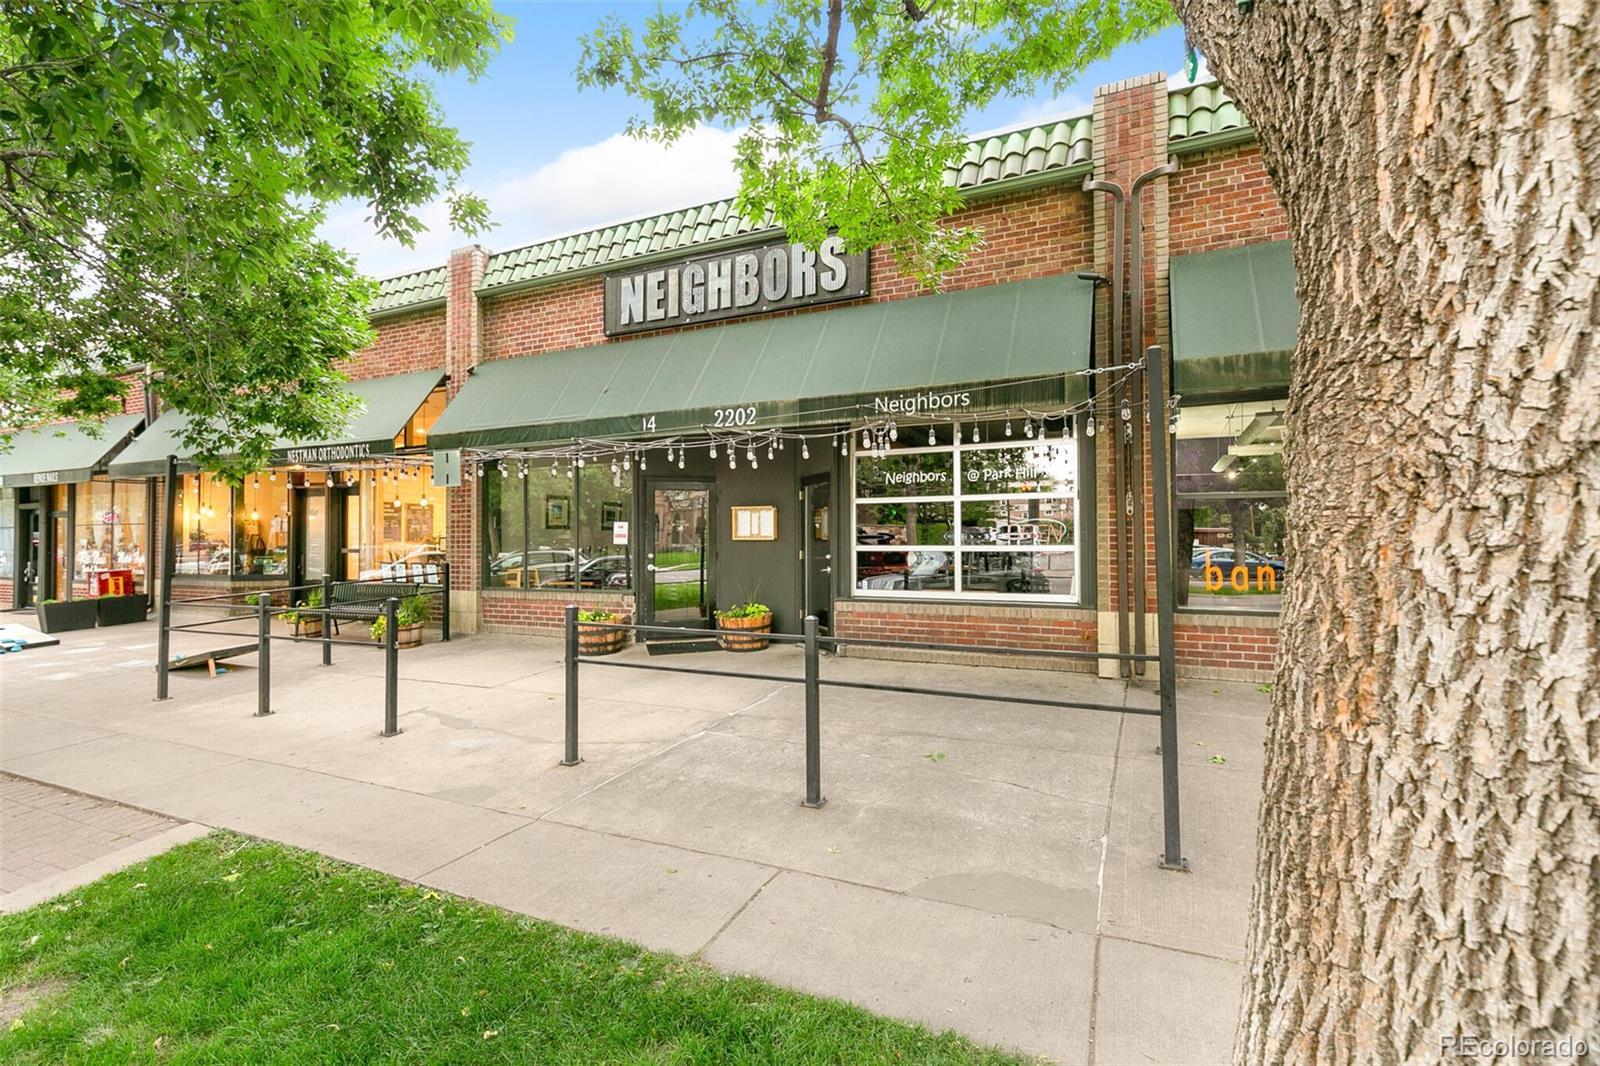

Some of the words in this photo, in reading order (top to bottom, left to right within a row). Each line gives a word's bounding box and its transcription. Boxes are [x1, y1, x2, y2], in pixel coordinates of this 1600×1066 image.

[620, 235, 848, 325] NEIGHBORS
[875, 391, 970, 415] Neighbors
[714, 406, 757, 428] 2202
[287, 447, 317, 463] NESTMAN
[318, 443, 370, 461] ORTHODONTICS
[885, 471, 947, 485] Neighbors
[982, 466, 1014, 481] Park
[1015, 465, 1037, 479] Hill
